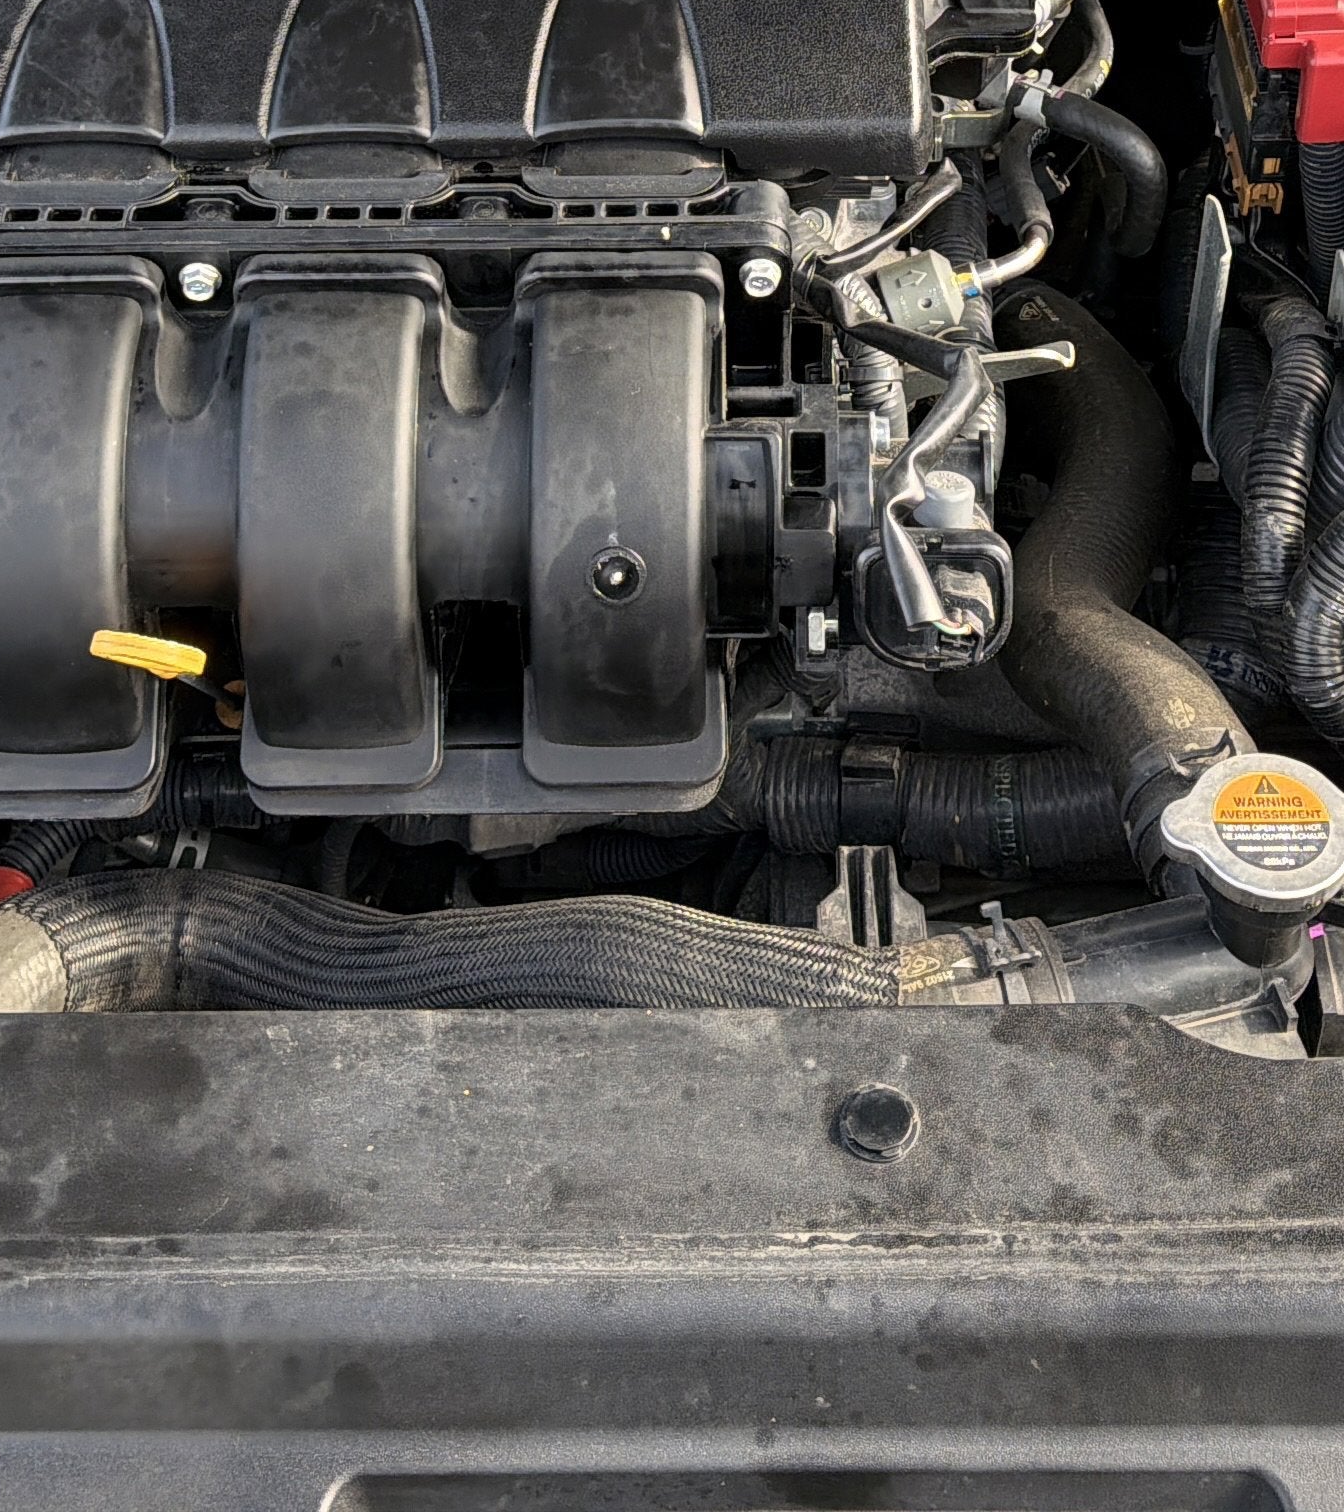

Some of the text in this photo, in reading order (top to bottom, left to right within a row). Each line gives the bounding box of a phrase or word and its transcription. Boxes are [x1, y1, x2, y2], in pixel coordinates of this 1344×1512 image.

[1232, 796, 1304, 808] WARNING
[1219, 809, 1323, 820] AVERTISSEMENT
[1222, 823, 1251, 832] NEVER
[1251, 823, 1276, 832] OPEN
[1276, 823, 1304, 832] WHEN
[1233, 832, 1262, 841] JAMAIS
